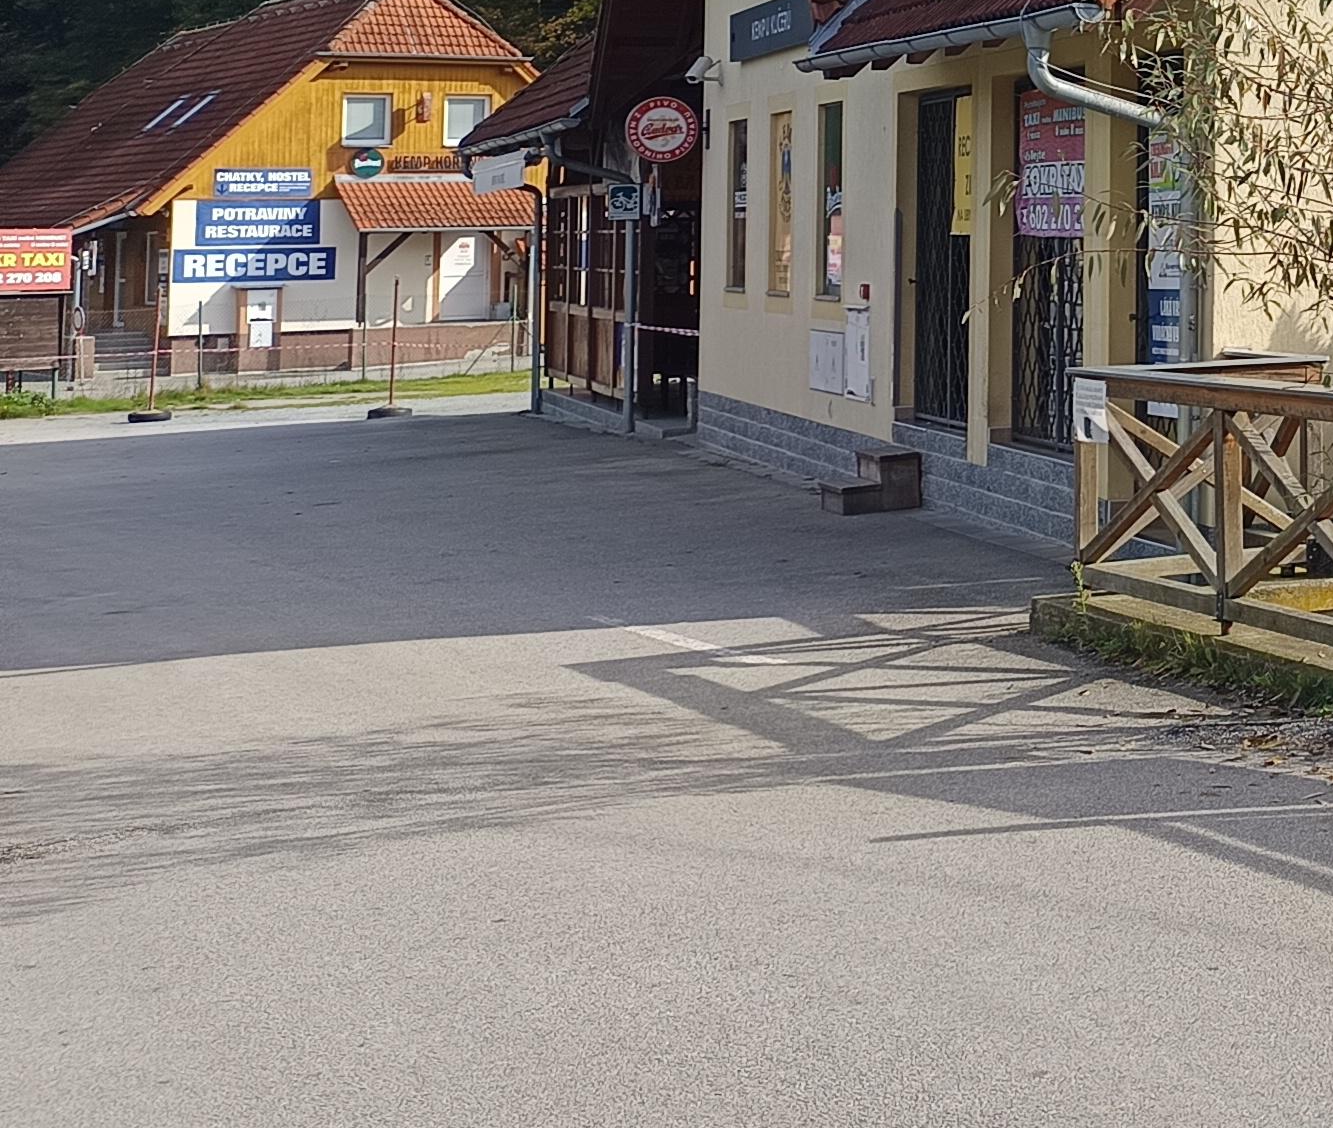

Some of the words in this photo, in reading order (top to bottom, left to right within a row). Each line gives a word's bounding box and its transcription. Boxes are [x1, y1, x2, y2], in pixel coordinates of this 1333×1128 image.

[649, 100, 678, 109] PIVO
[393, 155, 430, 170] KEMP
[216, 172, 265, 182] CHATKY,
[268, 172, 311, 182] HOSTEL
[228, 183, 278, 192] RECEPCE
[212, 207, 308, 221] POTRAVINY
[204, 225, 313, 239] RESTAURACE
[21, 253, 65, 267] TAXI
[183, 252, 327, 278] RECEPCE
[6, 273, 33, 284] 270
